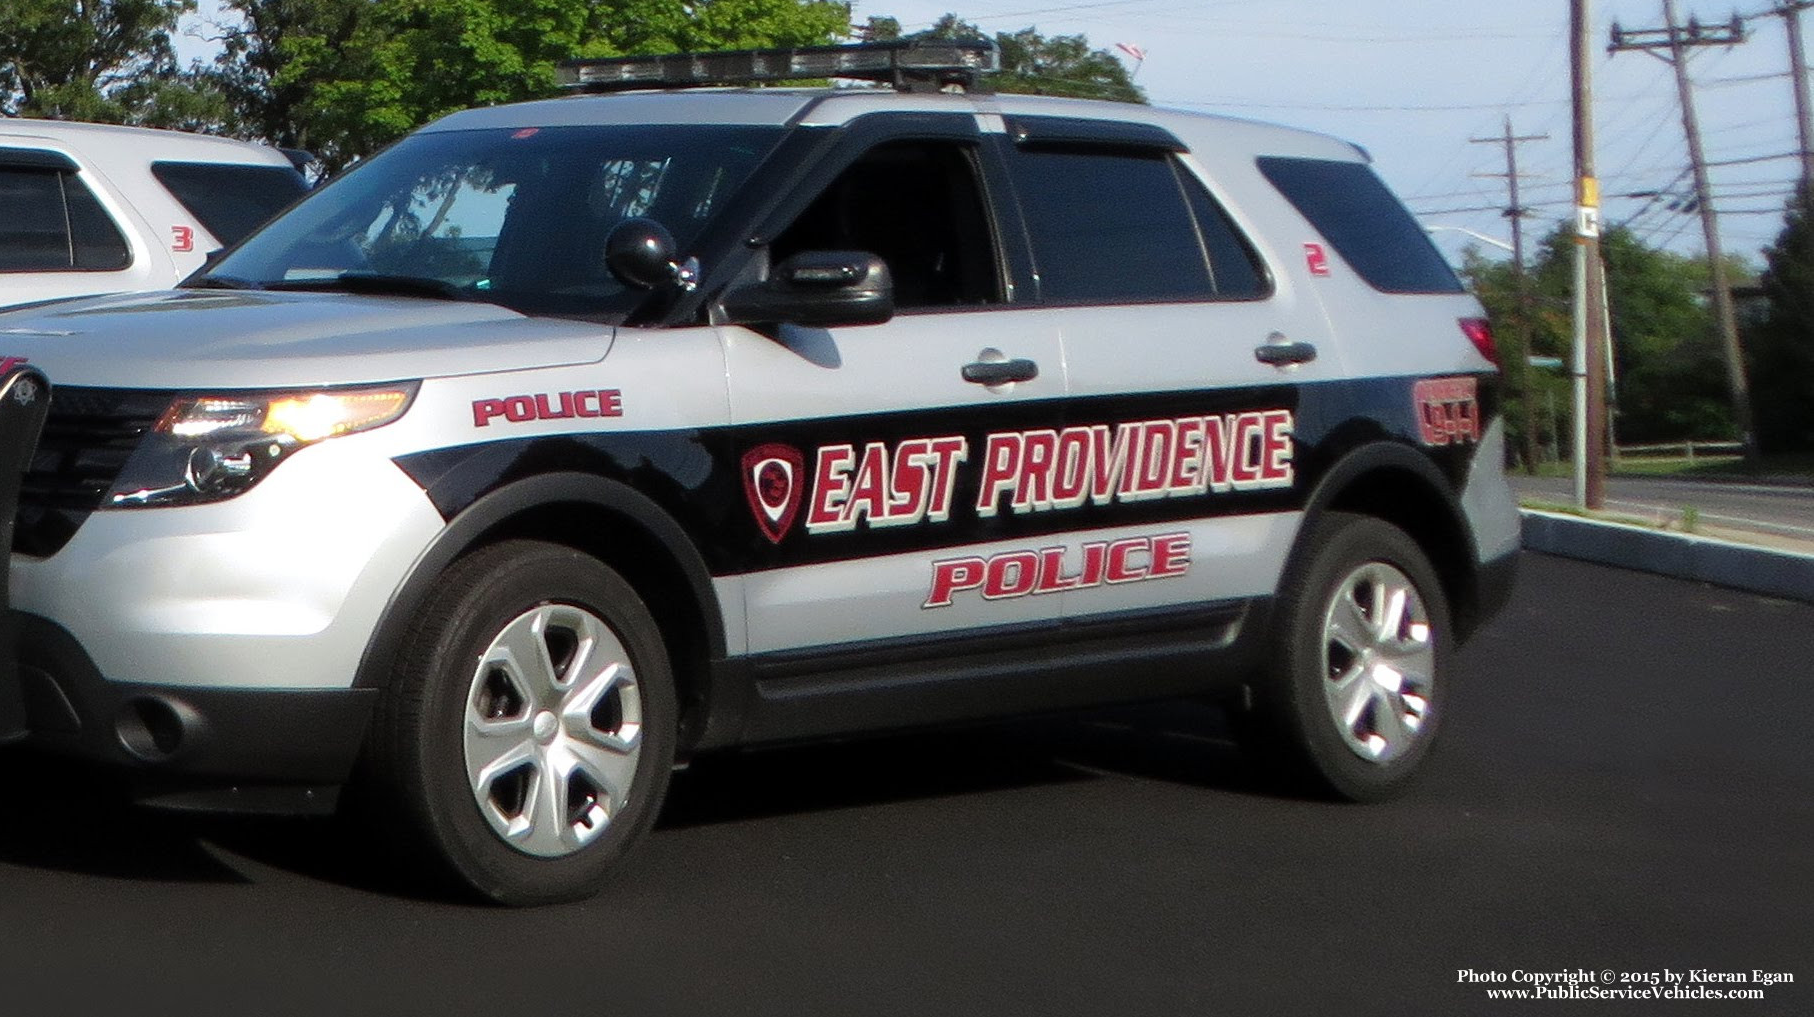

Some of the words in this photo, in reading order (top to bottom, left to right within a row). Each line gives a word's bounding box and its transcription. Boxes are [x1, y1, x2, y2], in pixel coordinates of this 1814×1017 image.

[170, 225, 194, 252] 3
[1302, 242, 1331, 277] 2
[472, 388, 624, 427] POLICE
[806, 435, 968, 535] EAST
[976, 410, 1295, 518] PROVIDENCE
[922, 533, 1191, 608] POLICE
